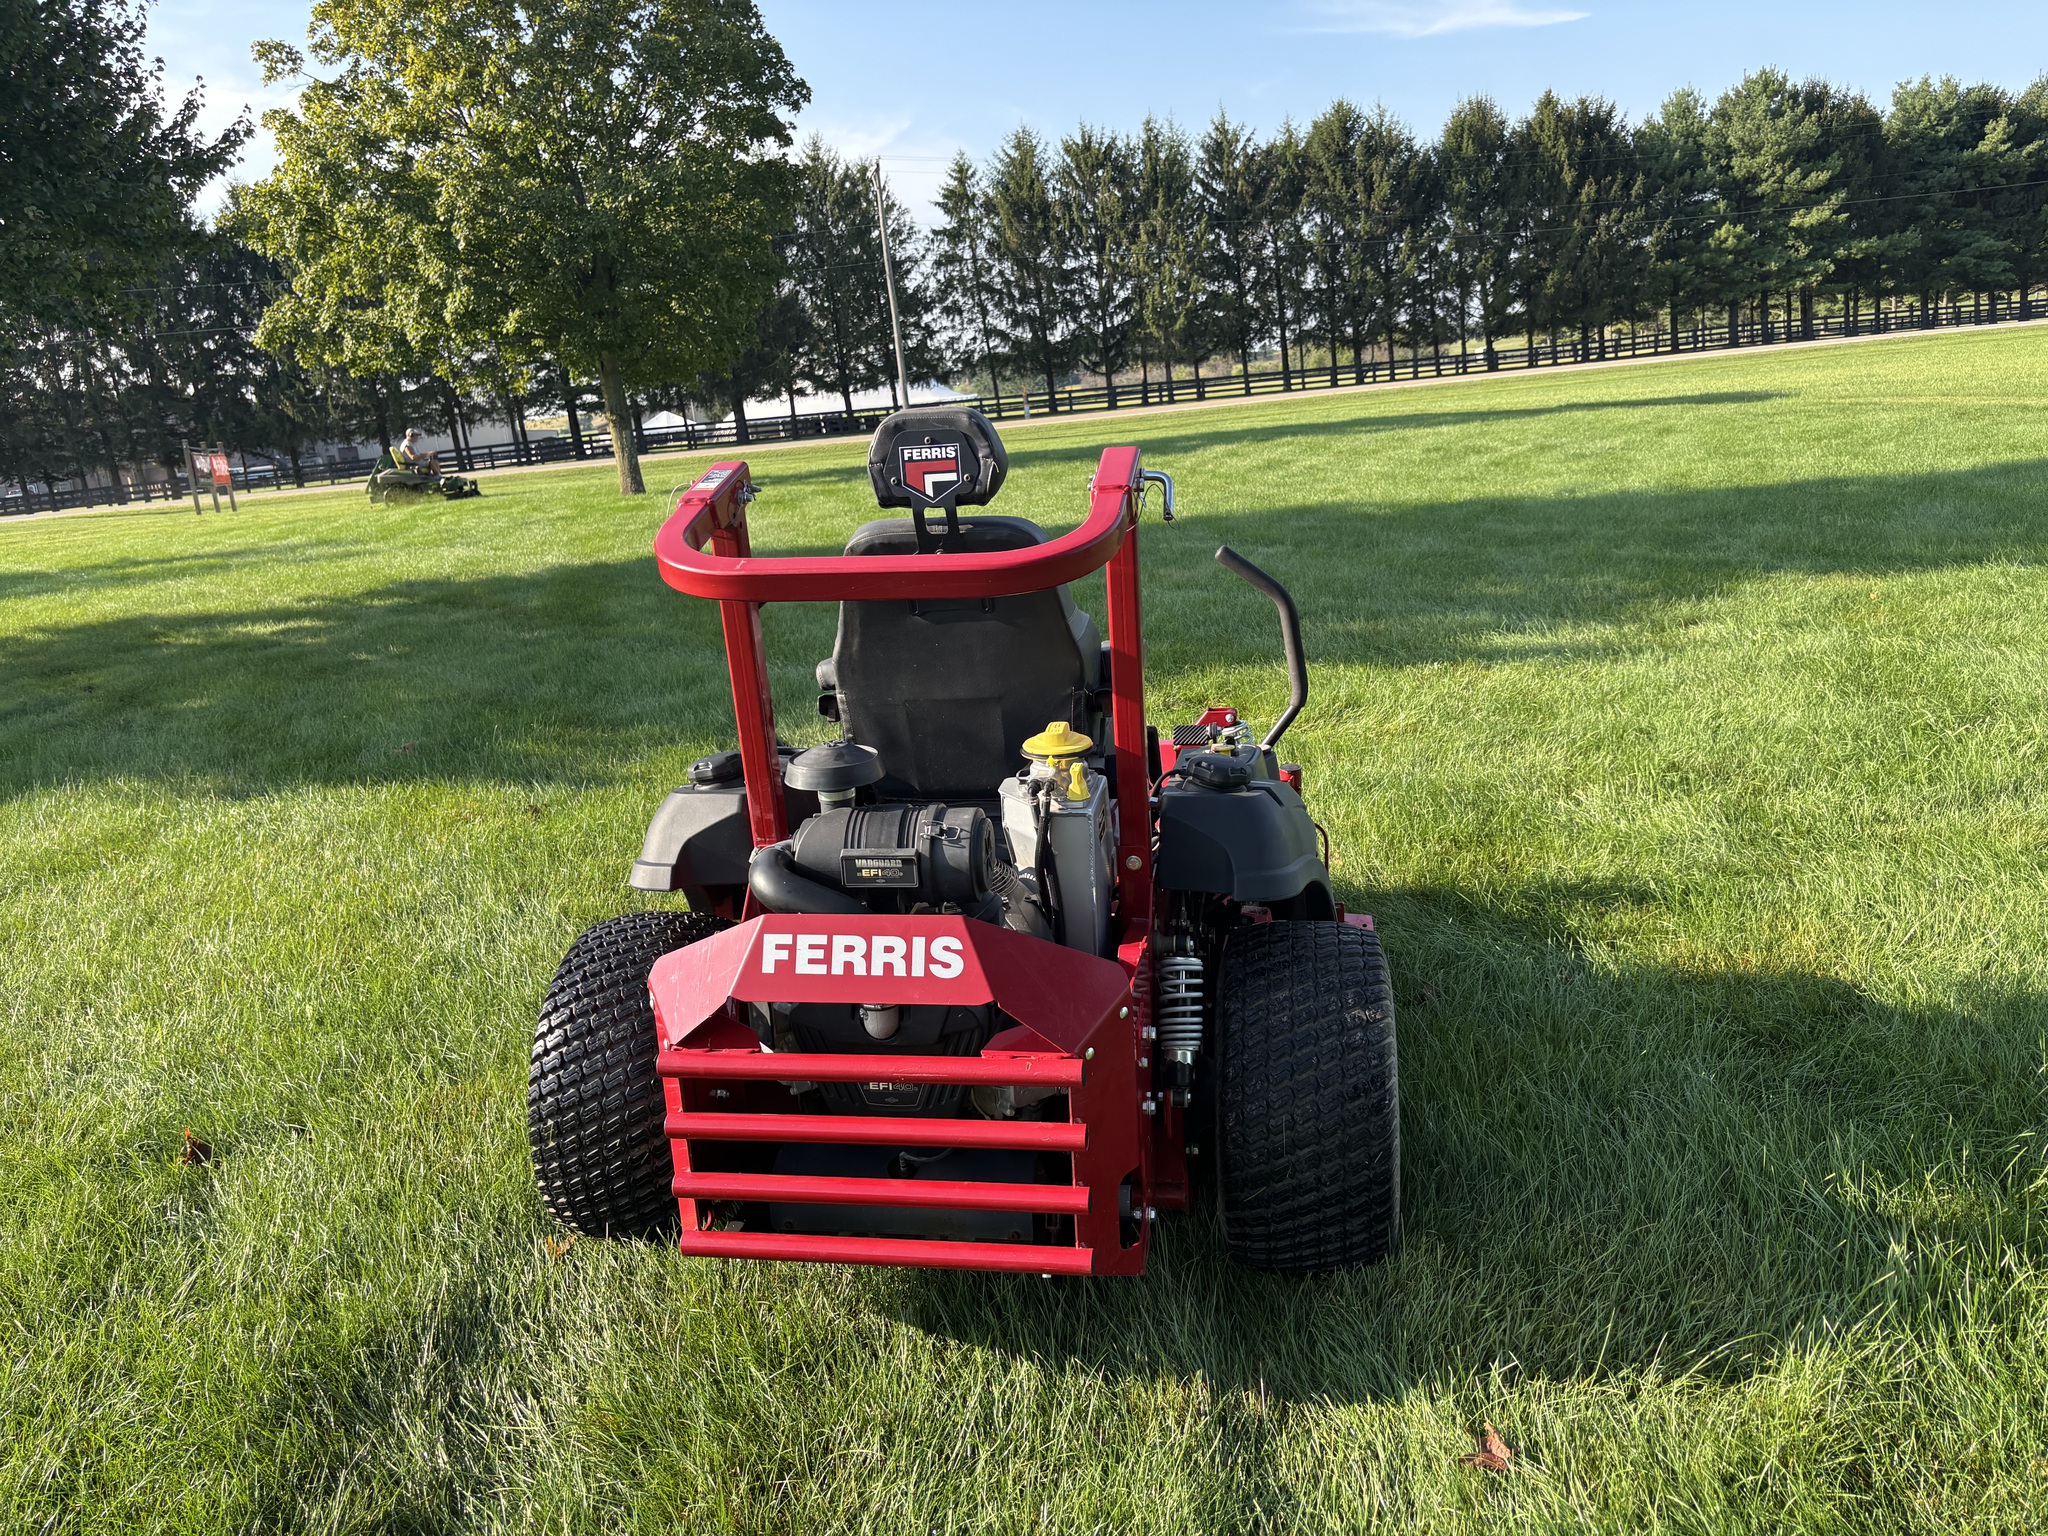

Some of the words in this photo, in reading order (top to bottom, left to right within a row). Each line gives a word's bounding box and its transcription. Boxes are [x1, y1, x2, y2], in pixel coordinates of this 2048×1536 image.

[903, 446, 956, 461] FERRIS
[855, 858, 903, 868] VANGUARD
[761, 933, 965, 979] FERRIS
